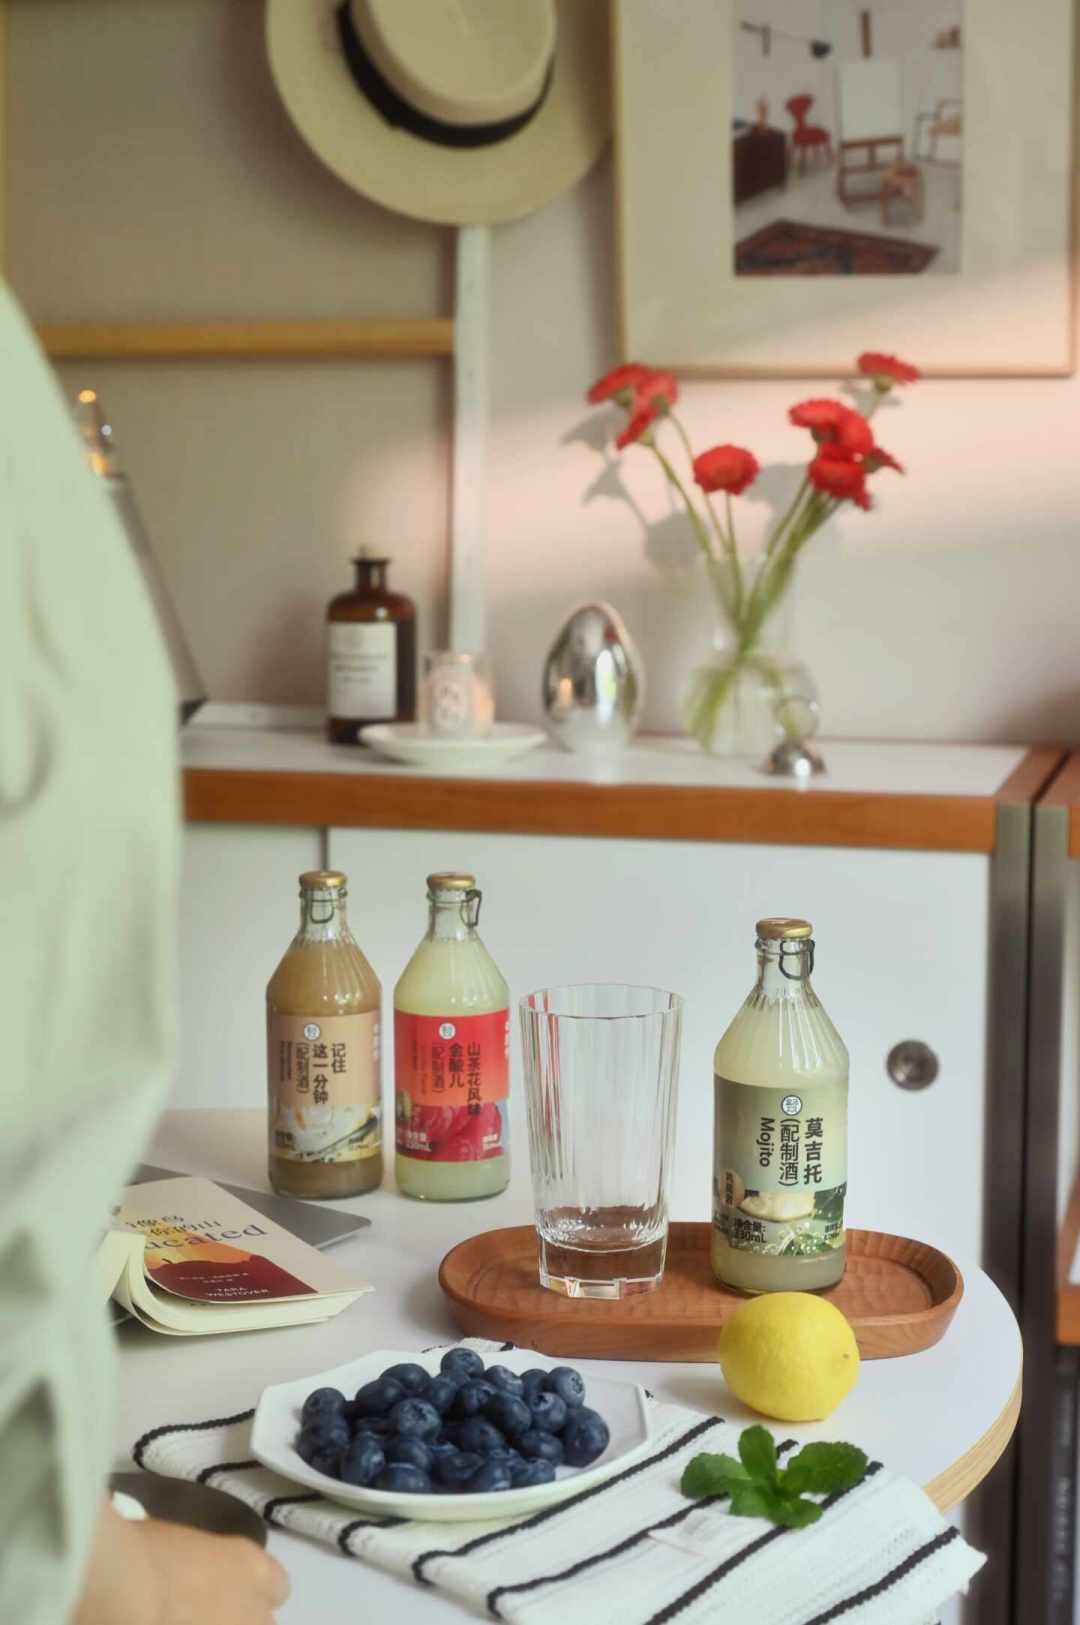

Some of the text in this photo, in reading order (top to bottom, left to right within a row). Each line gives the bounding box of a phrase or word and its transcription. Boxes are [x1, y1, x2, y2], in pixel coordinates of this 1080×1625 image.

[312, 1042, 328, 1104] 这一分钟
[331, 1042, 346, 1074] 记住
[756, 1117, 775, 1167] Mojito
[778, 1118, 800, 1187] (配制酒)
[804, 1117, 823, 1184] 莫吉托
